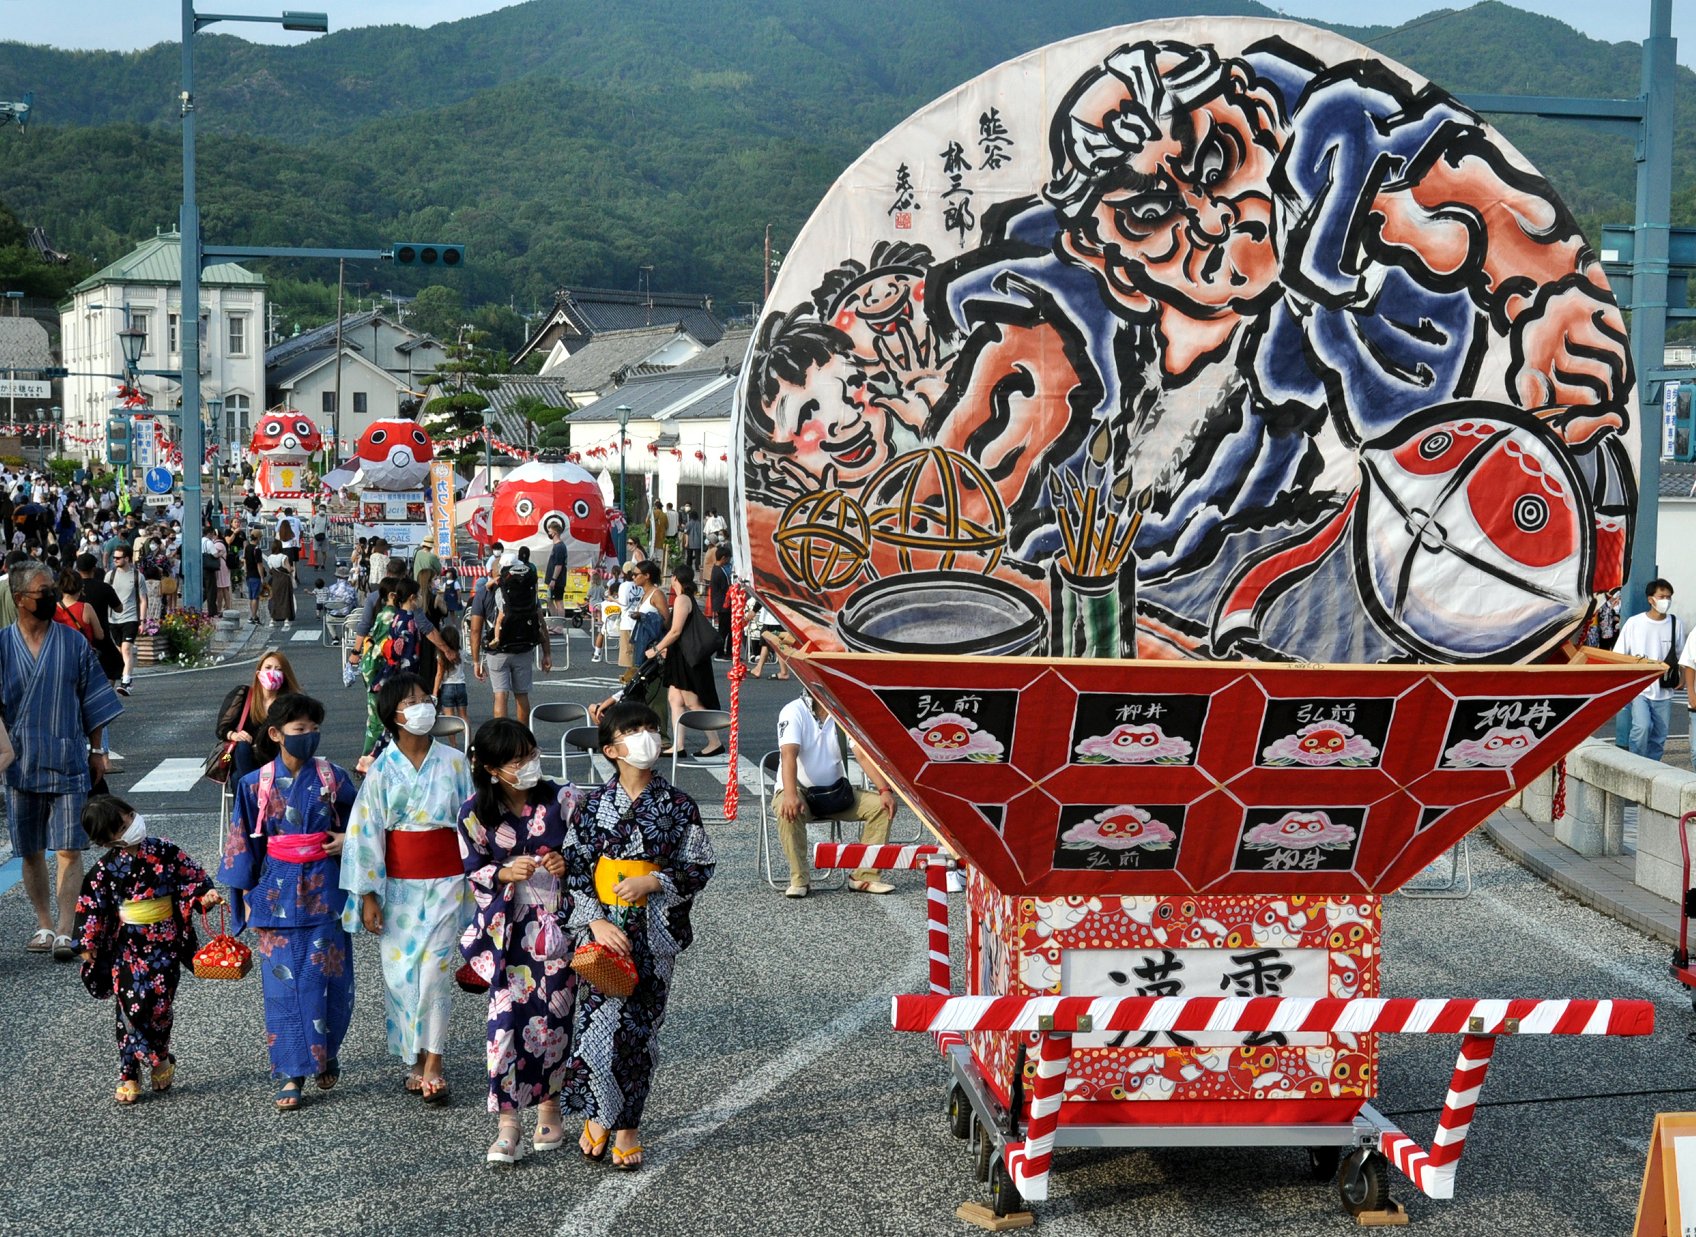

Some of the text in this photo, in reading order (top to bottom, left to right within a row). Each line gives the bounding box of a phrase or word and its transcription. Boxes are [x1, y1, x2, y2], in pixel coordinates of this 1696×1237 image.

[917, 694, 982, 719] 弘前
[1115, 702, 1168, 721] 柳井
[1296, 702, 1356, 723] 弘前
[1473, 699, 1556, 730] 柳井
[1086, 851, 1140, 868] 弘前
[1262, 848, 1327, 870] 柳井
